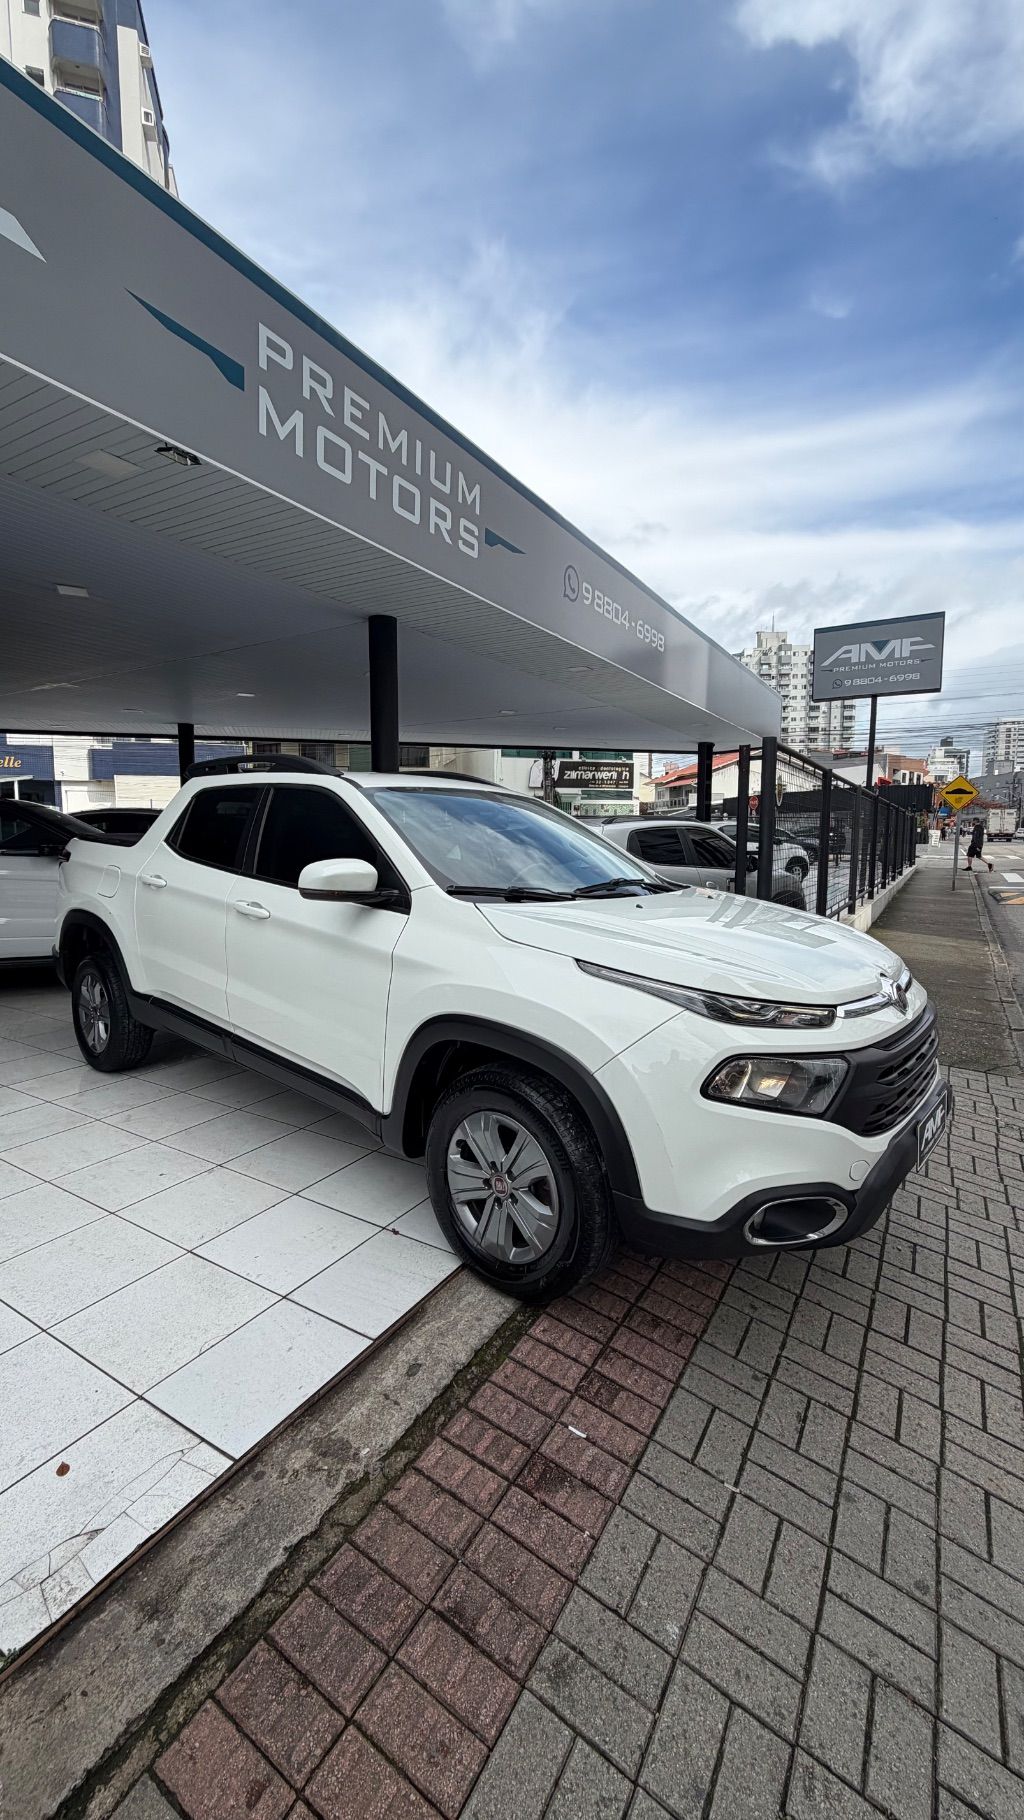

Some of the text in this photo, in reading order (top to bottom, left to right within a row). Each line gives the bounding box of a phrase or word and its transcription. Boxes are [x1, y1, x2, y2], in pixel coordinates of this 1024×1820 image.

[258, 322, 481, 516] PREMIUM
[258, 385, 480, 559] MOTORS
[820, 636, 936, 667] AMF
[833, 658, 920, 673] PREMIUM MOTORS
[921, 1104, 945, 1151] AMF
